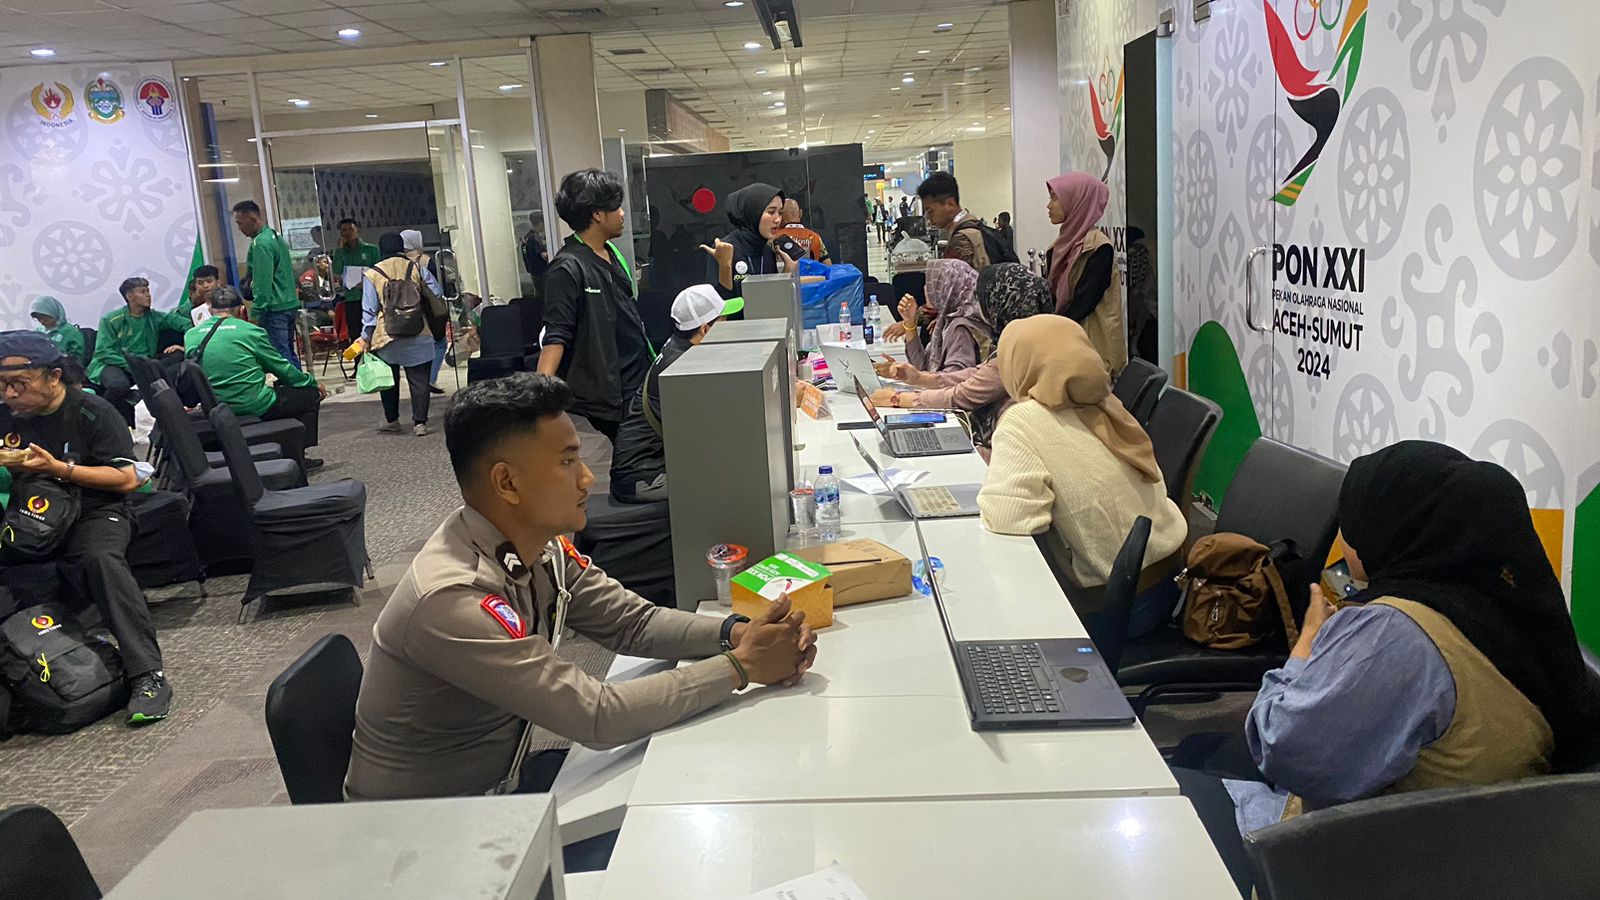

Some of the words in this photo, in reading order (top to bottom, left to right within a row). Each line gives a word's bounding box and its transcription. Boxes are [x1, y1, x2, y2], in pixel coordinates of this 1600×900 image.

[39, 118, 73, 128] INDONESIA
[1272, 244, 1318, 288] PON
[1322, 246, 1366, 293] XXI
[1272, 289, 1292, 303] PEKAN
[1292, 292, 1327, 309] OLAHRAGA
[1327, 297, 1364, 316] NASIONAL
[1273, 308, 1364, 352] ACEH-SUMUT
[1297, 348, 1331, 380] 2024
